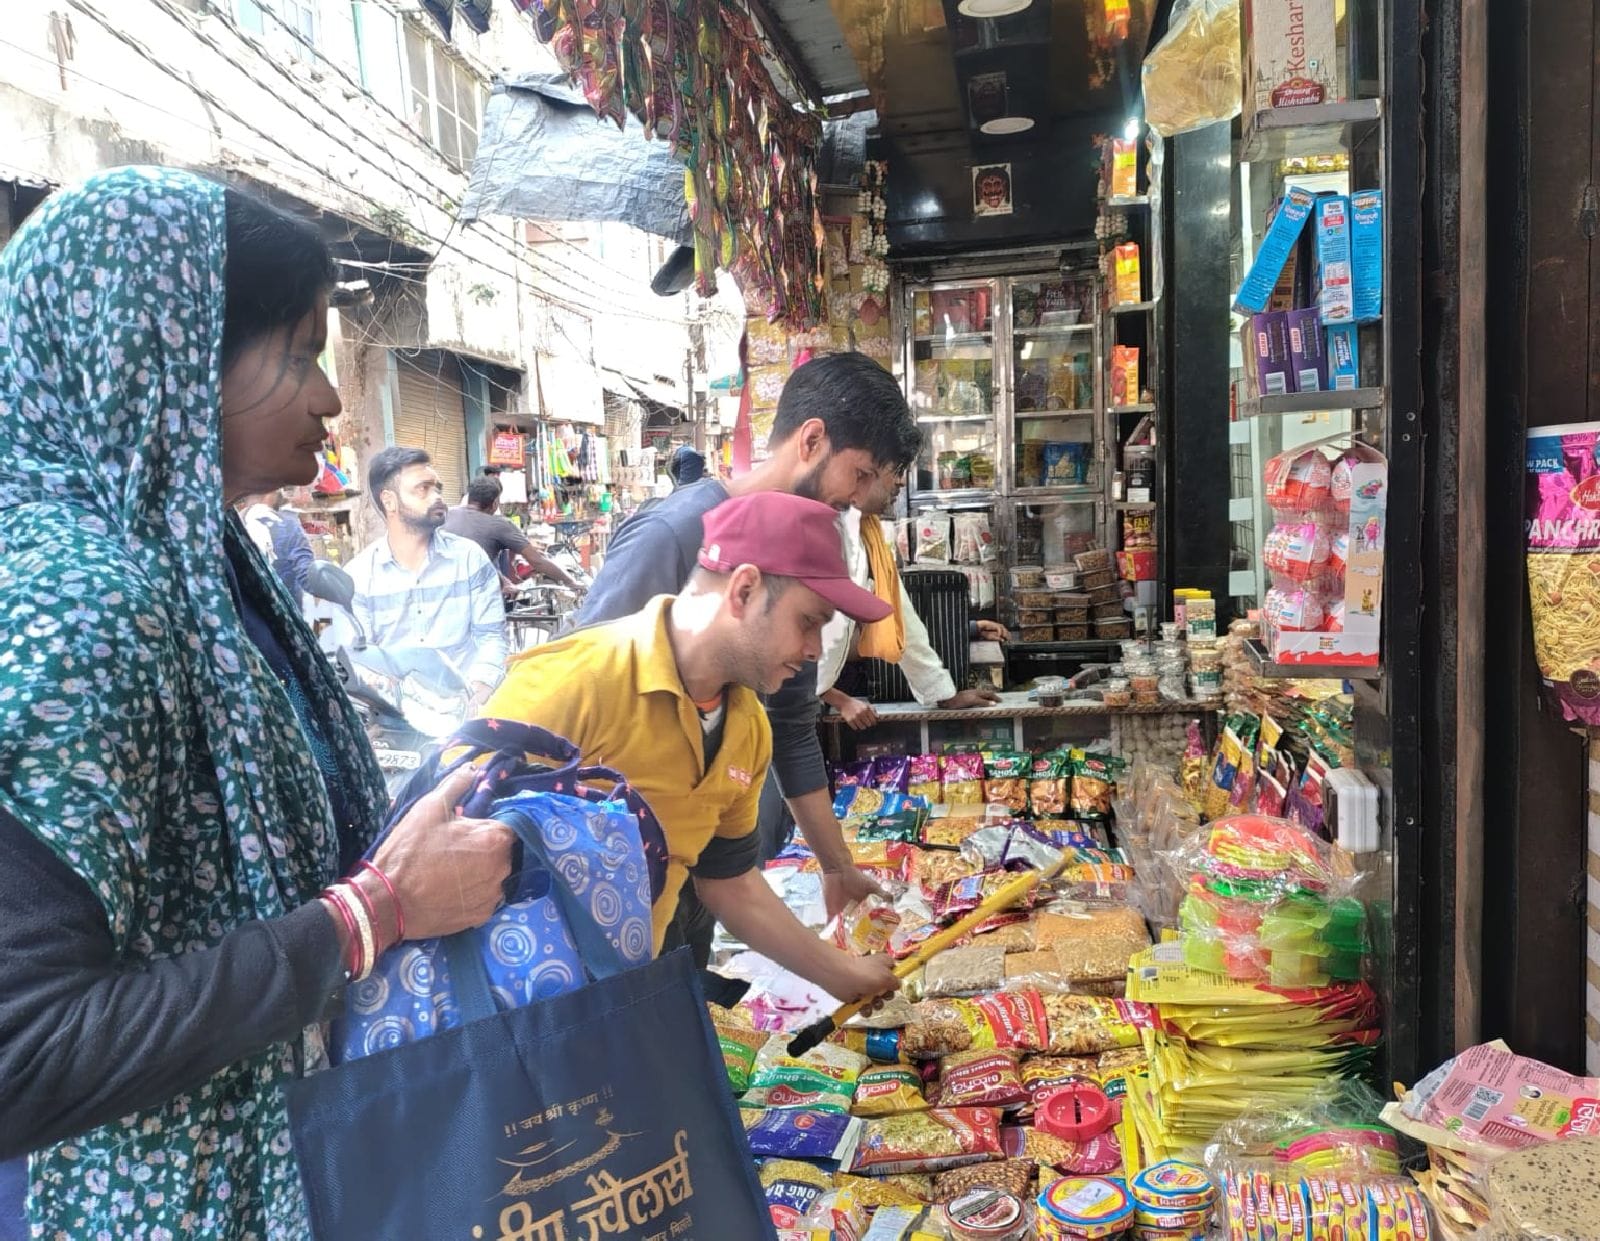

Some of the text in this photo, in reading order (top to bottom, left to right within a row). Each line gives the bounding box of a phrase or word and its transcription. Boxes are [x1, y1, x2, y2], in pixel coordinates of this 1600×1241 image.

[1285, 0, 1305, 72] Keshar
[1535, 457, 1560, 469] PACK
[519, 1112, 543, 1131] जय
[545, 1101, 564, 1121] श्री
[567, 1091, 600, 1117] कृष्ण
[1275, 1193, 1290, 1223] VIMAL
[1290, 1202, 1304, 1234] VIMAL
